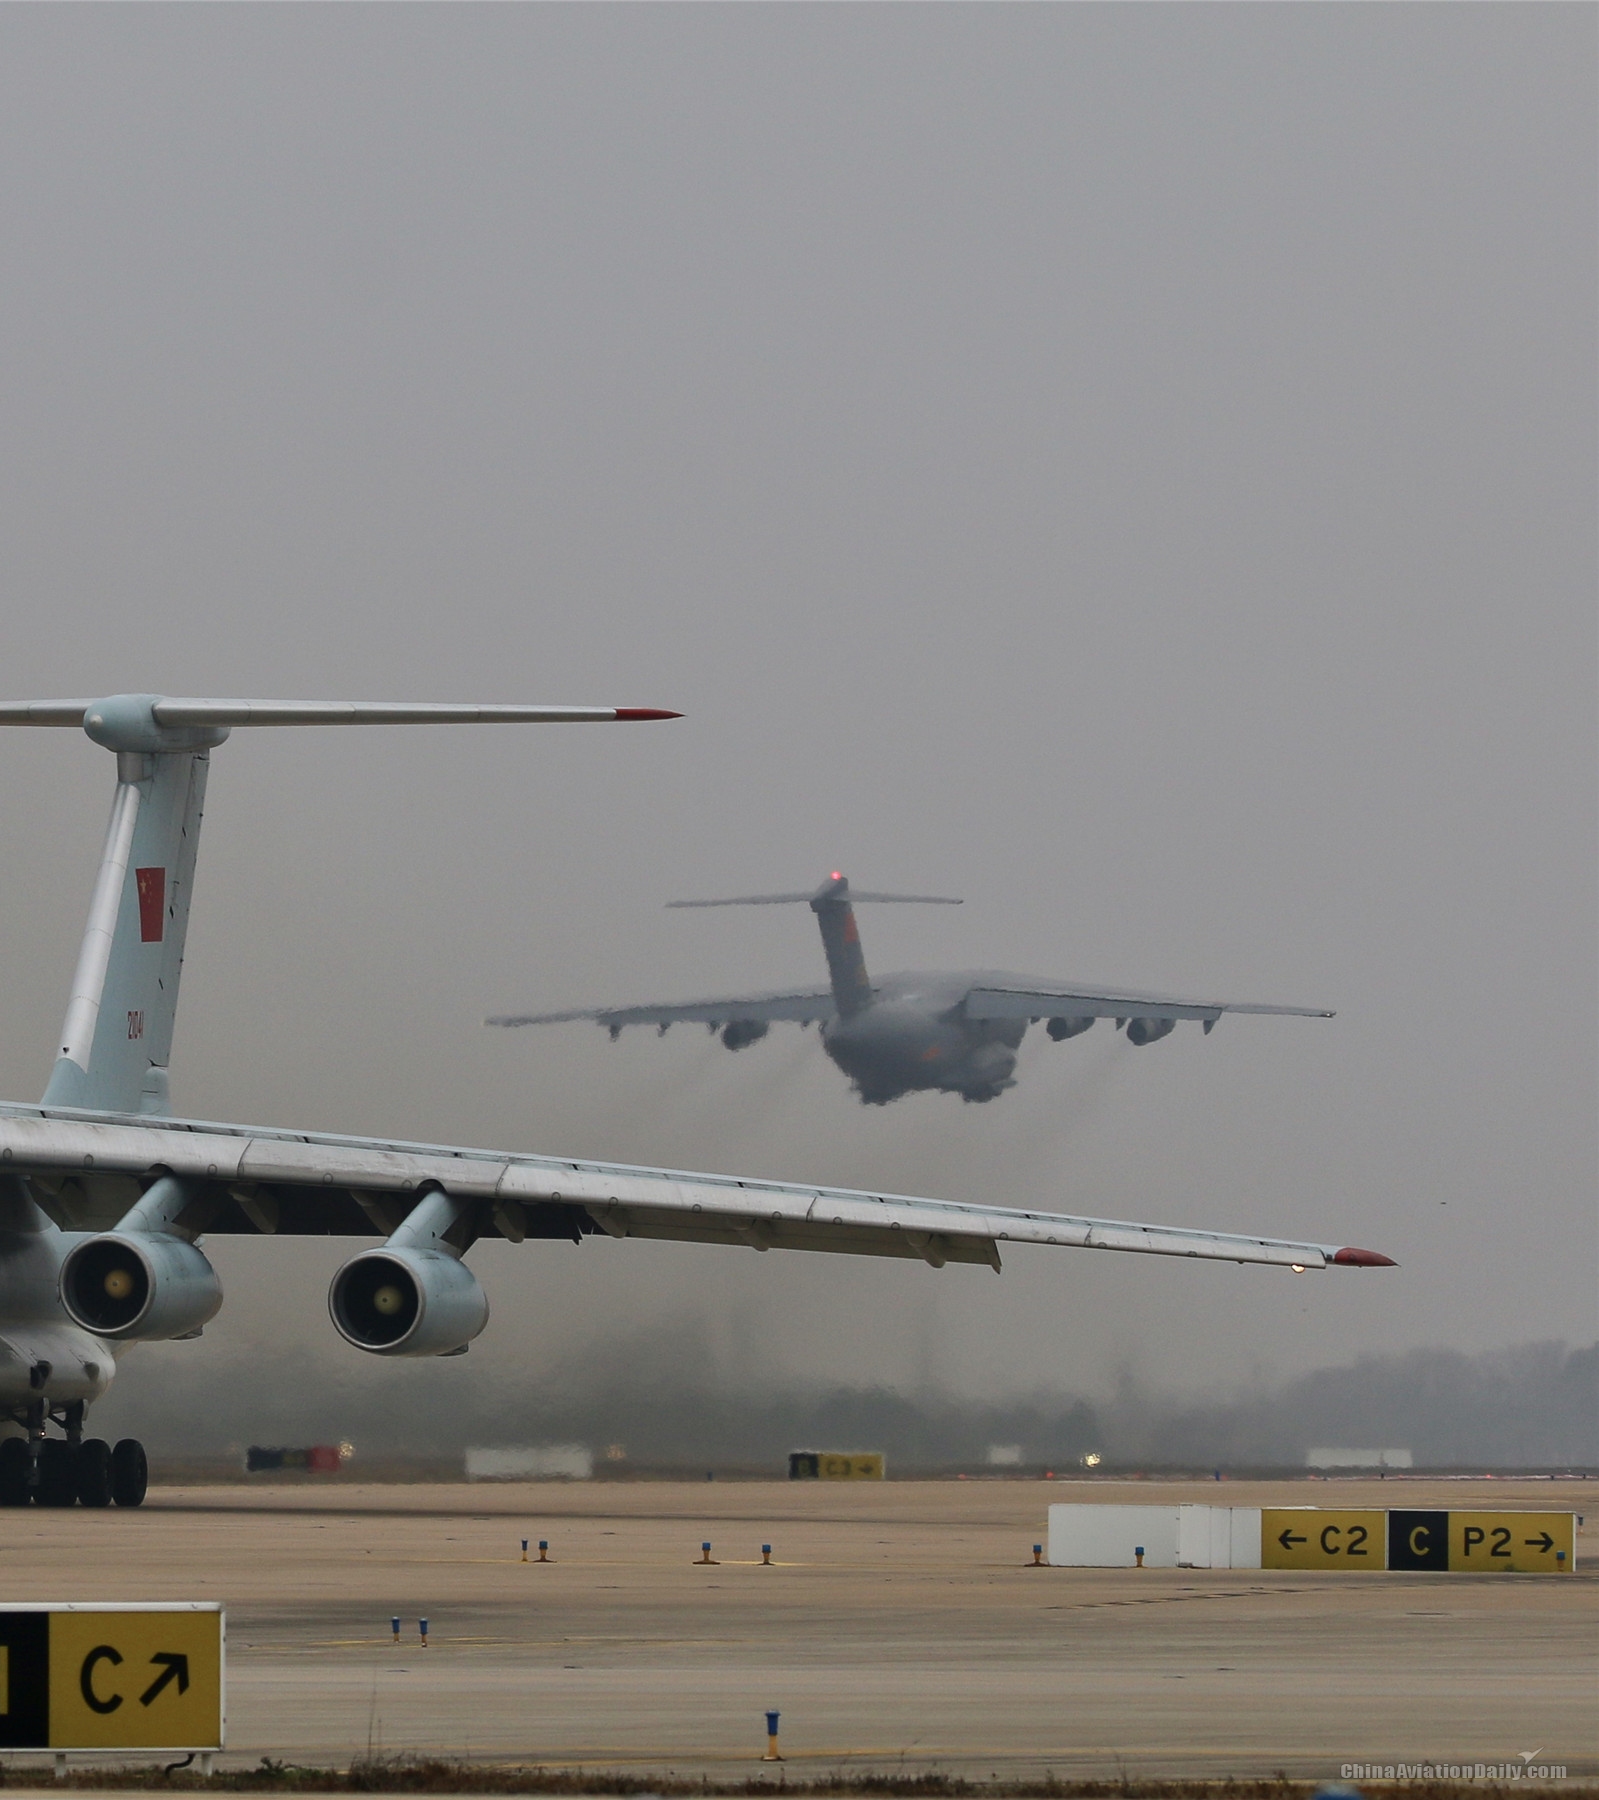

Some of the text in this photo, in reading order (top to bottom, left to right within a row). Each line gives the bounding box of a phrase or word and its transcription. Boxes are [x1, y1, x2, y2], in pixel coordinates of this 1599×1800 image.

[1320, 1525, 1511, 1557] C2 C P2
[80, 1644, 124, 1715] C
